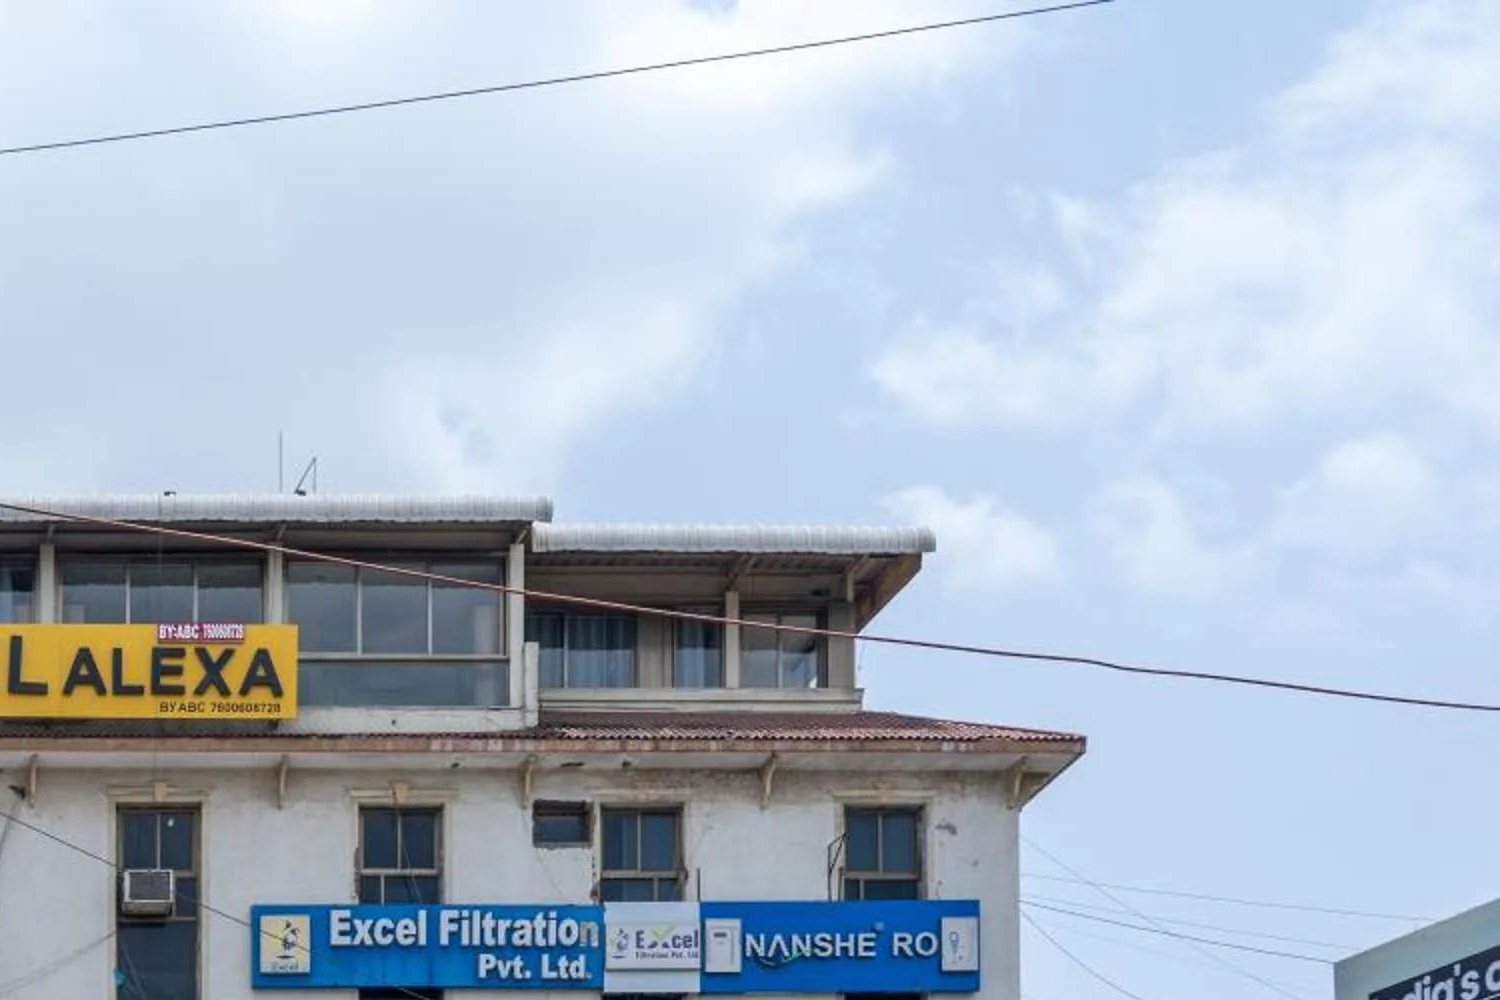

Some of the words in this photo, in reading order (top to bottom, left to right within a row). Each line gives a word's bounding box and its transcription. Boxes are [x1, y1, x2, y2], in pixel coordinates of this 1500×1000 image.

[63, 646, 284, 698] ALEXA
[329, 909, 427, 947] Excel
[439, 909, 599, 948] Filtration
[892, 931, 938, 957] RO
[477, 953, 532, 980] Pvt.
[541, 953, 593, 980] Ltd.
